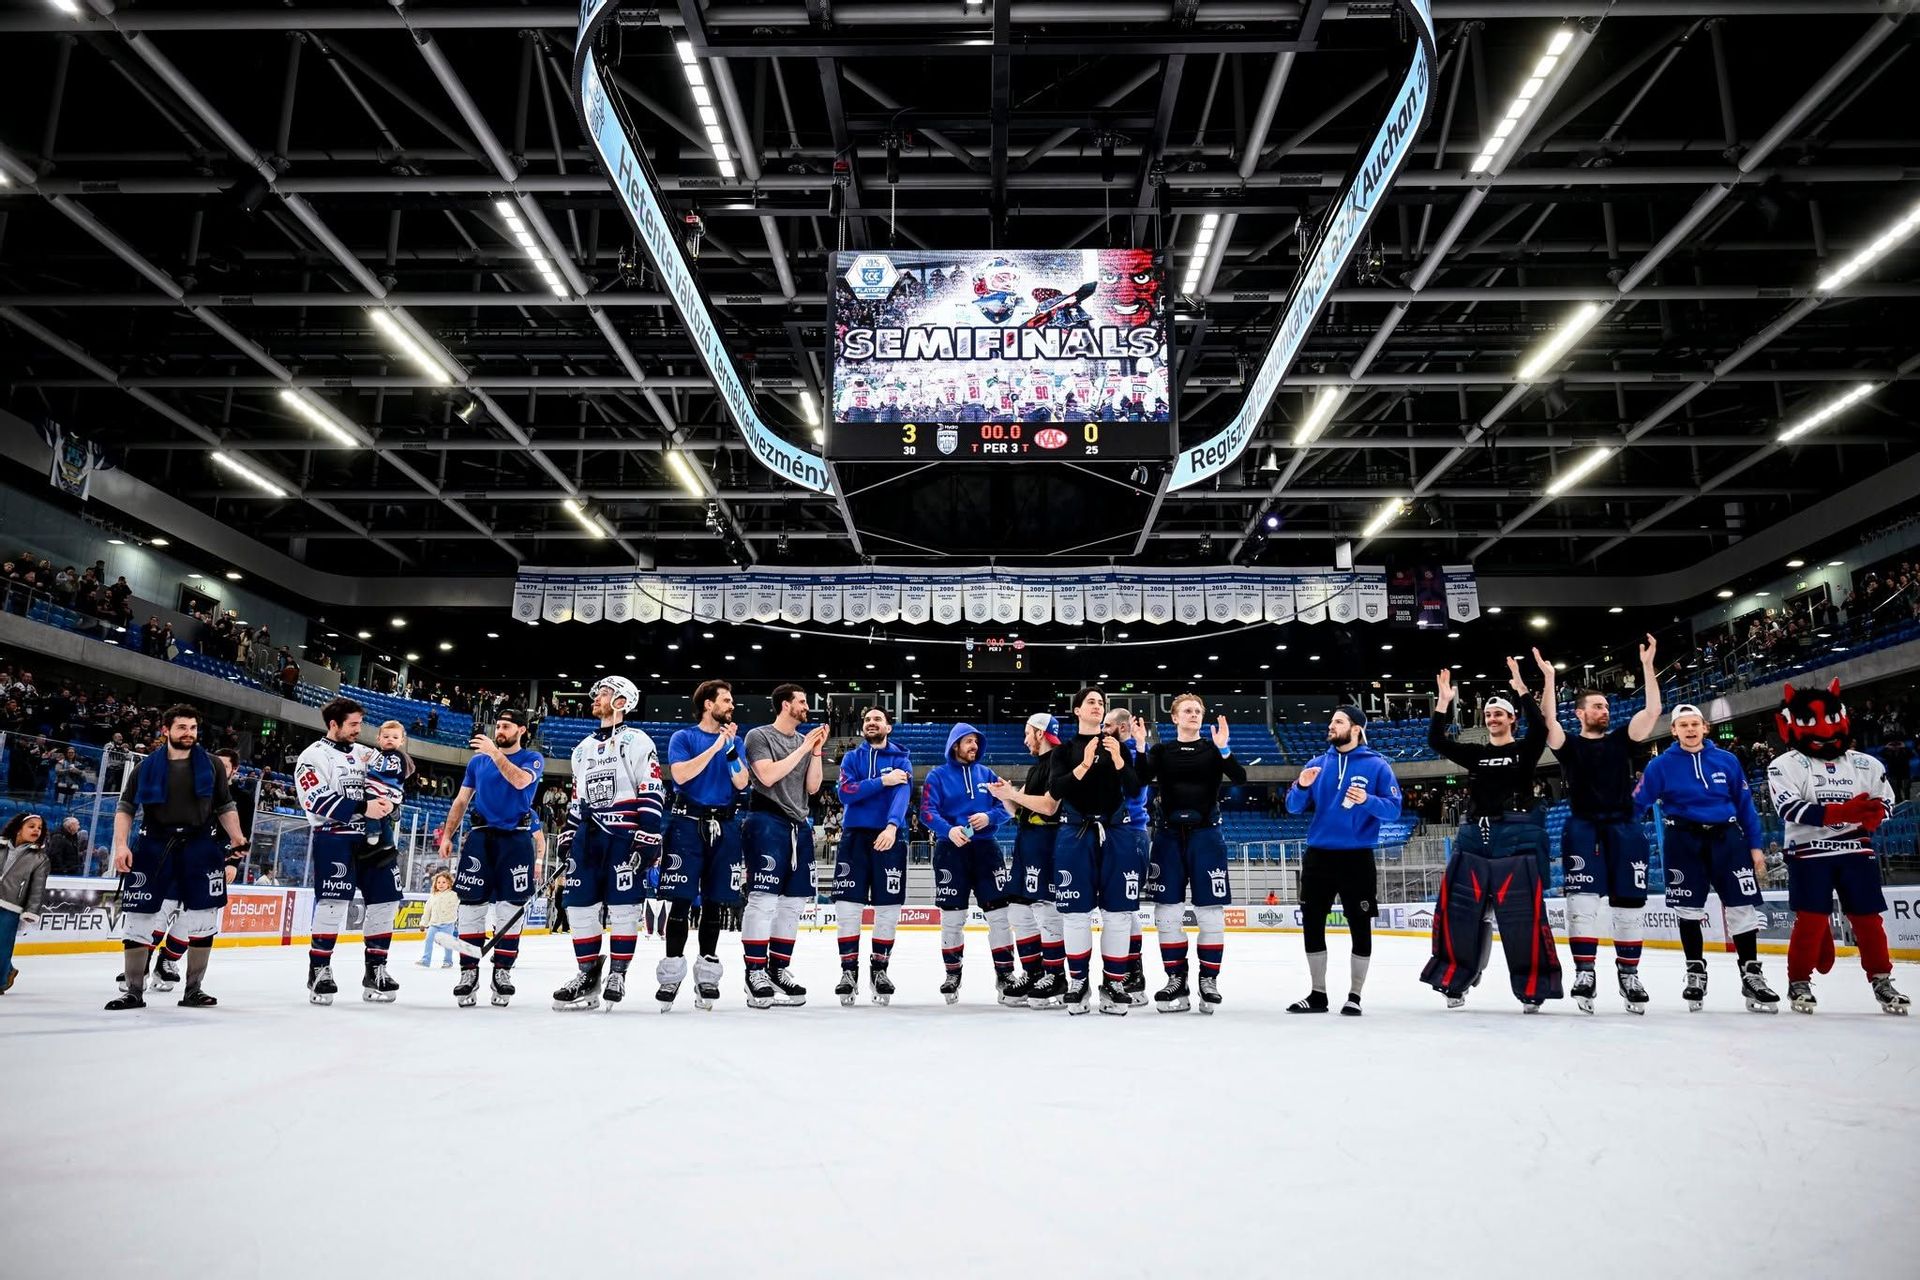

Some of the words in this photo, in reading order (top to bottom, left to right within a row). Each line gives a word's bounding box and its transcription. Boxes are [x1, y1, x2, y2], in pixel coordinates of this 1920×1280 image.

[1362, 86, 1418, 207] Auchan
[619, 144, 673, 278] Hetente
[675, 265, 711, 355] változó
[714, 345, 831, 491] termékkedvezmény
[842, 326, 1159, 360] SEMIFINALS
[855, 396, 868, 407] 35
[902, 424, 917, 444] 3
[981, 425, 1022, 440] 00.0
[1084, 424, 1099, 443] 0
[1038, 430, 1063, 447] KAC
[903, 446, 916, 455] 30
[983, 443, 1008, 454] PER
[1011, 443, 1018, 453] 3
[1086, 446, 1099, 455] 25
[967, 661, 973, 669] 3
[619, 744, 625, 758] C
[597, 756, 618, 766] Hydro
[299, 771, 320, 793] 59
[1828, 778, 1853, 786] Hydro
[1811, 840, 1862, 850] TIPPMIX
[457, 872, 485, 887] Hydro
[563, 877, 582, 887] dro
[661, 873, 688, 884] Hydro
[754, 873, 780, 885] Hydro
[1564, 874, 1594, 884] Hydro
[322, 880, 352, 891] Hydro
[123, 890, 153, 901] Hydro
[936, 886, 958, 897] ydro
[1056, 889, 1081, 900] Hydro
[1665, 887, 1693, 897] Hydro
[230, 900, 277, 915] absurd
